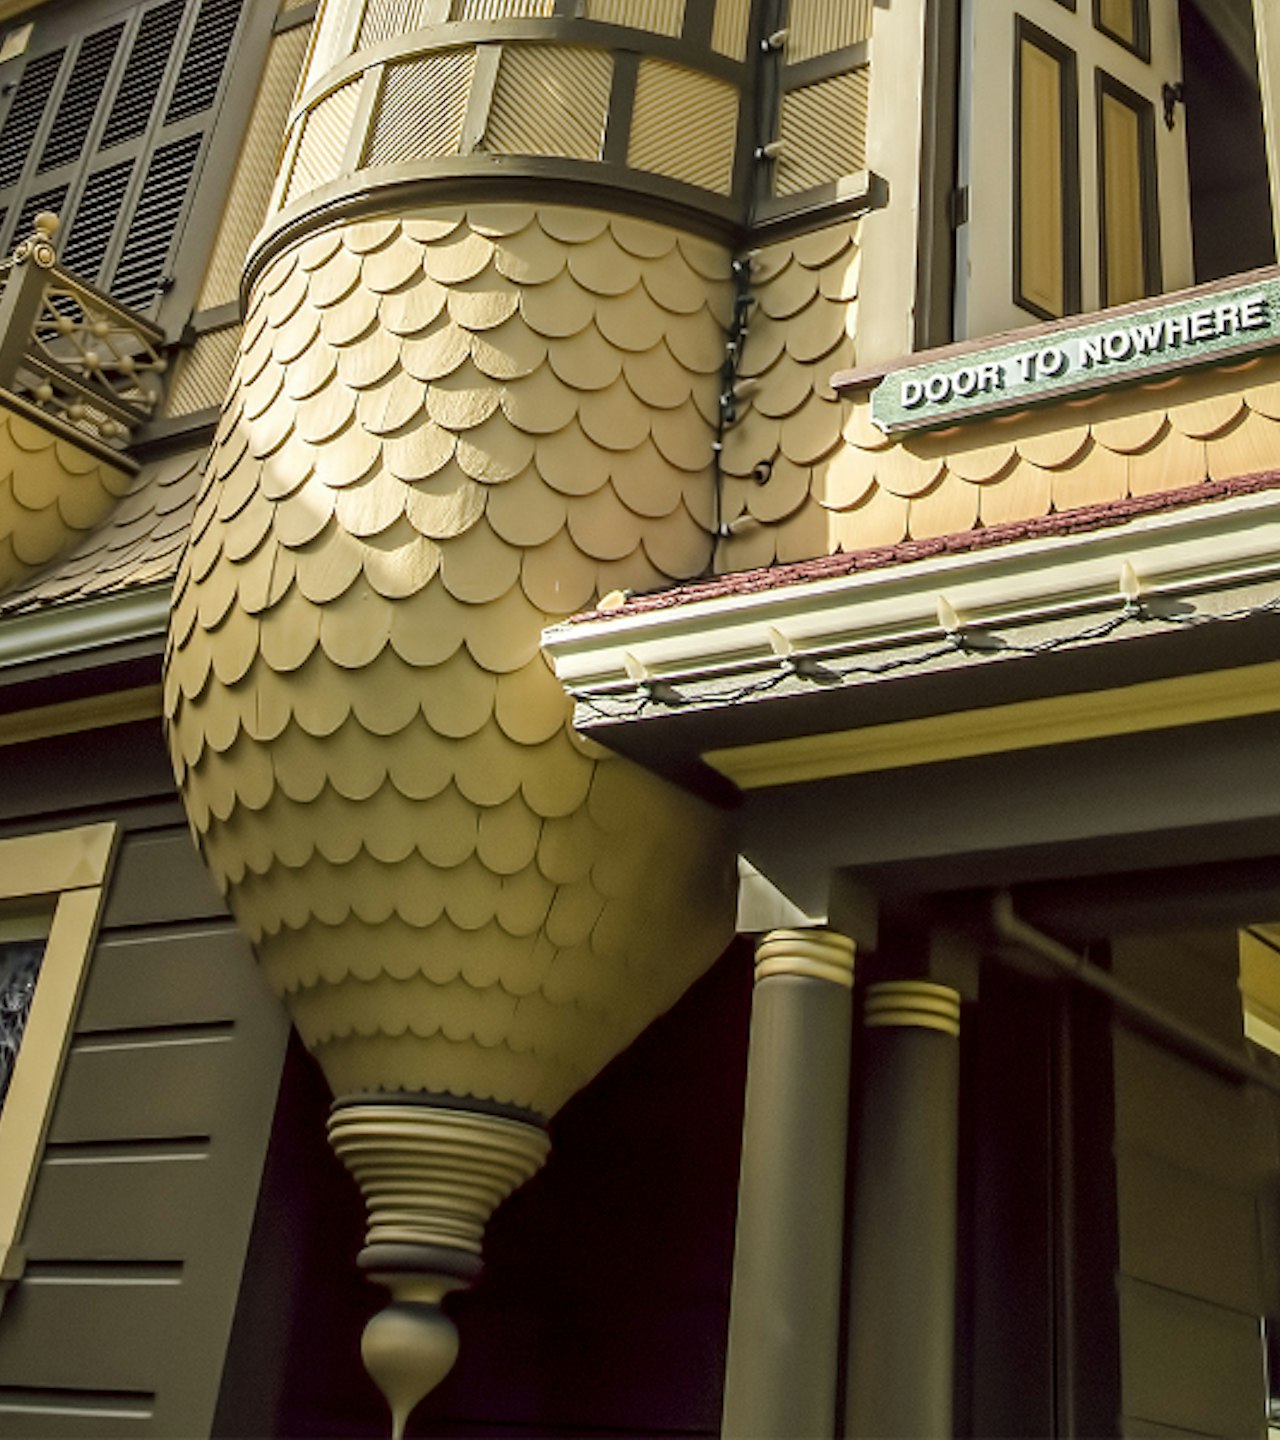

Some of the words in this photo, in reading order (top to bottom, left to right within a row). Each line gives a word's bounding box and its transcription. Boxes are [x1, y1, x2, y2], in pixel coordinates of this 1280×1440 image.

[900, 364, 1003, 408] DOOR
[1018, 345, 1065, 383] TO
[1079, 297, 1269, 368] NOWHERE
